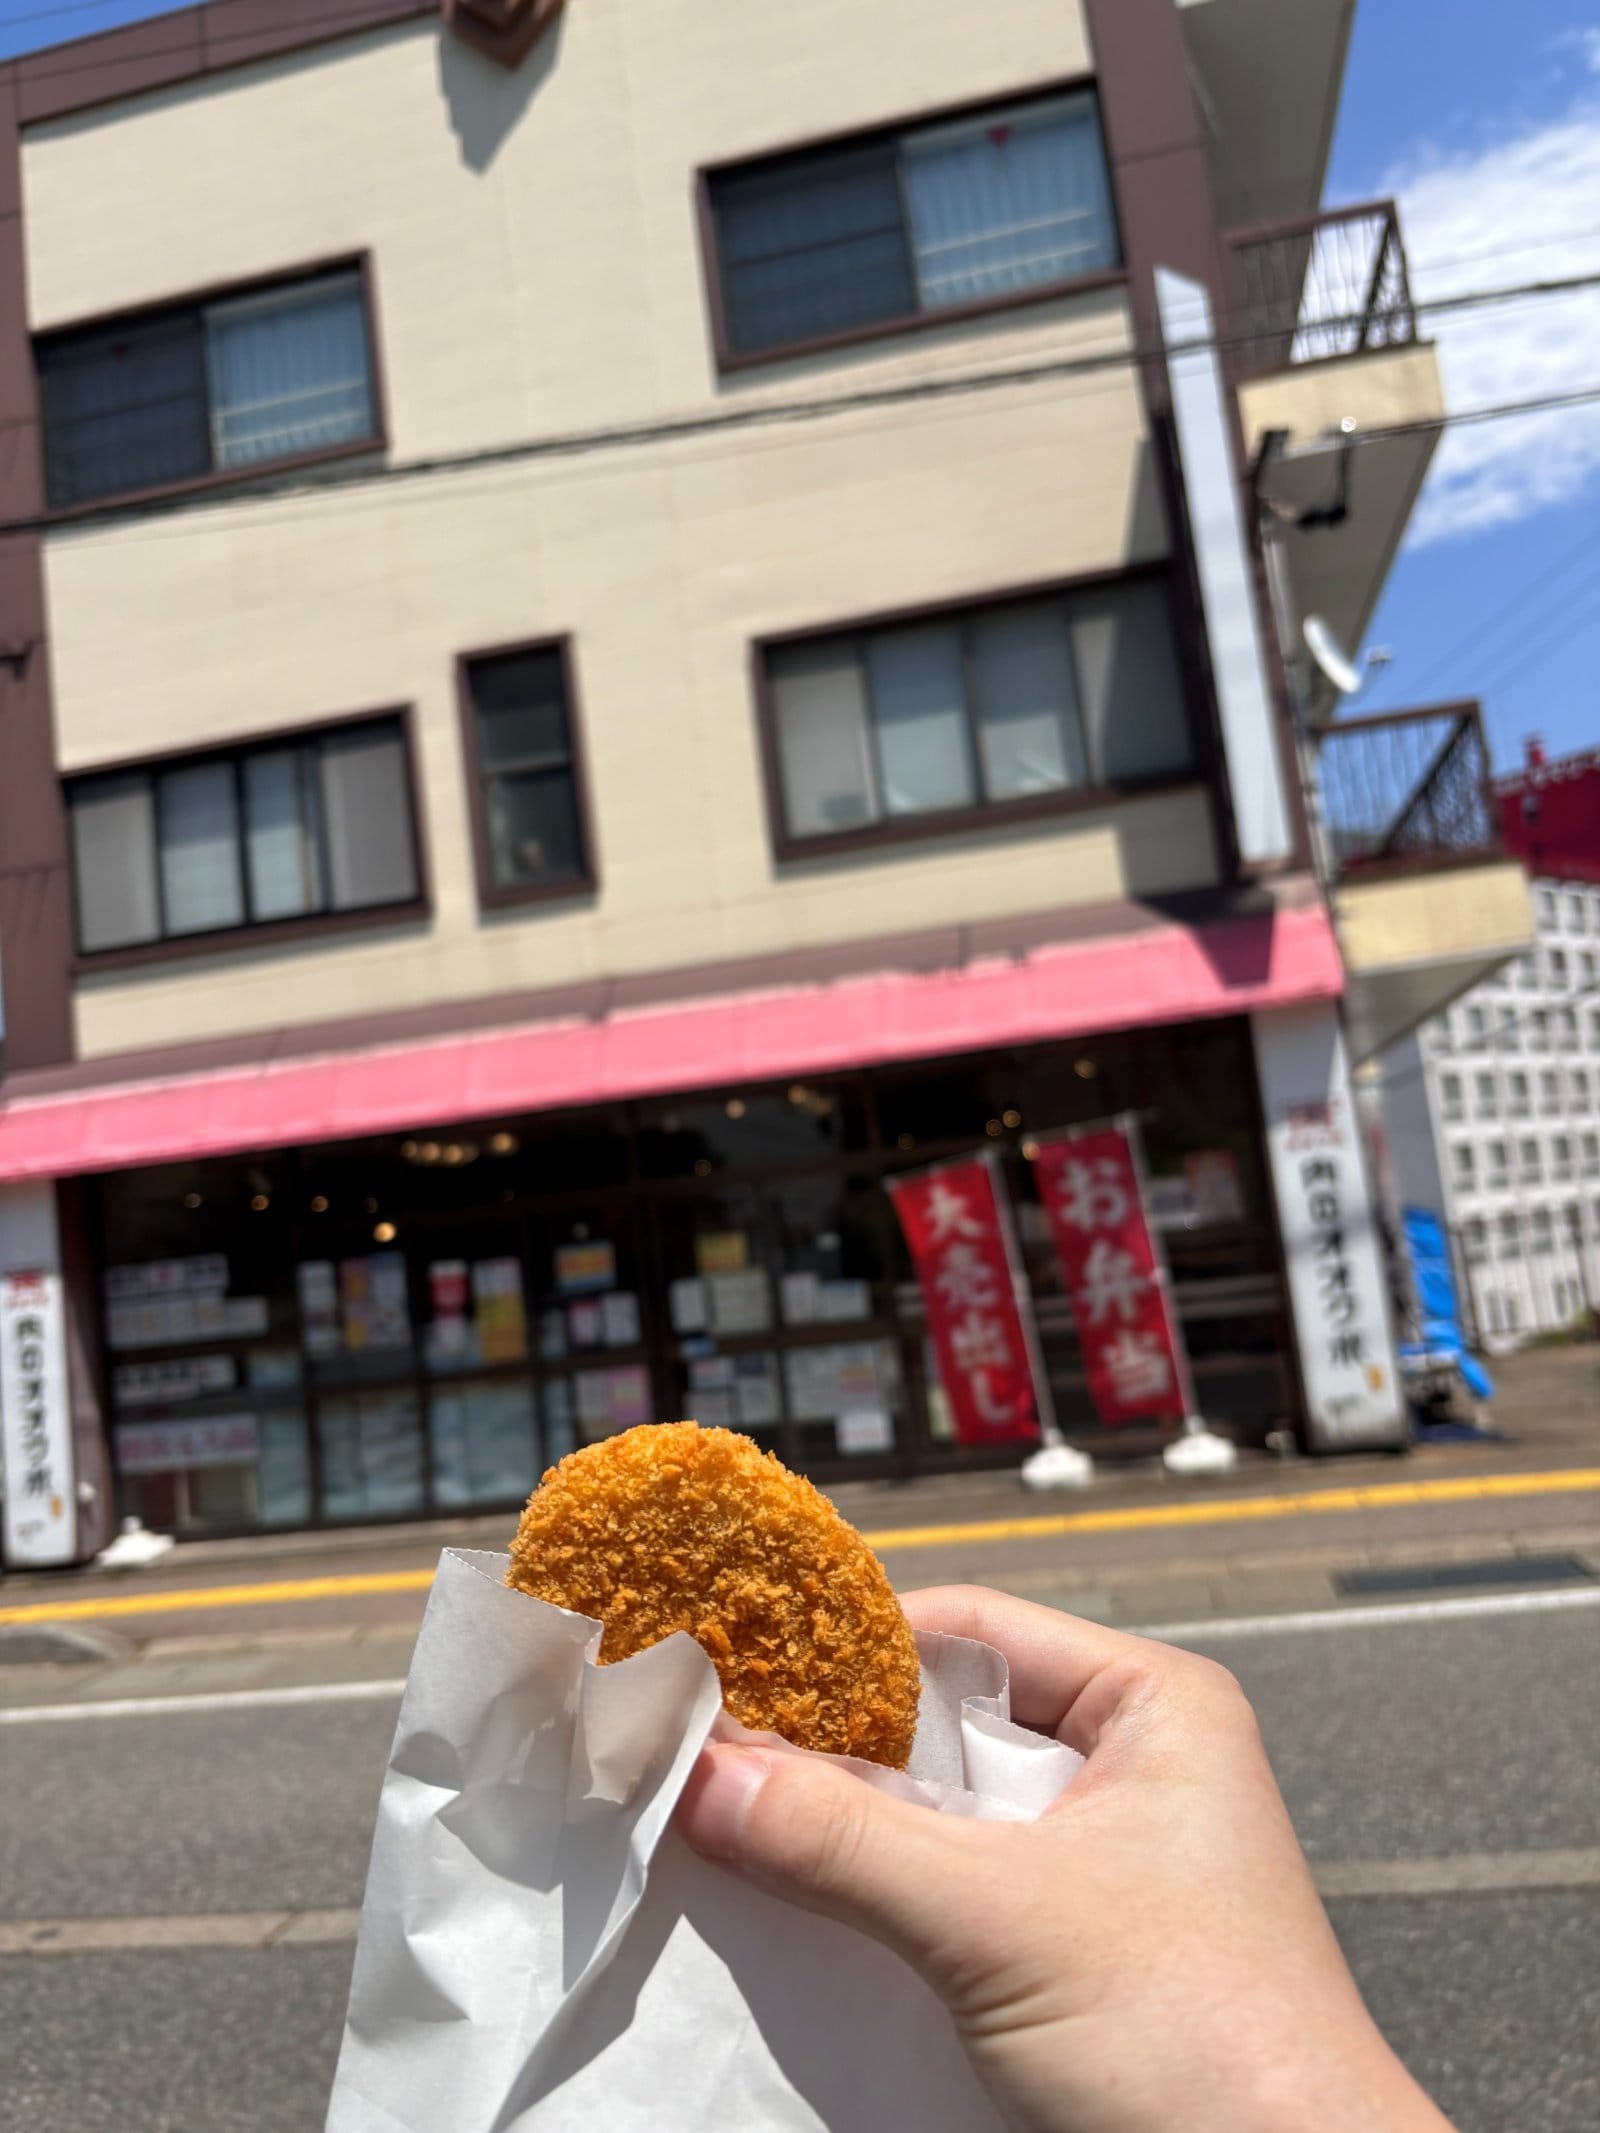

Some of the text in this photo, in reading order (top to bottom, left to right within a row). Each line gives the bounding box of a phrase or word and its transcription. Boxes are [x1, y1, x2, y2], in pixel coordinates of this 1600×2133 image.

[922, 1184, 1013, 1423] 大売出し
[1057, 1159, 1172, 1404] お弁当
